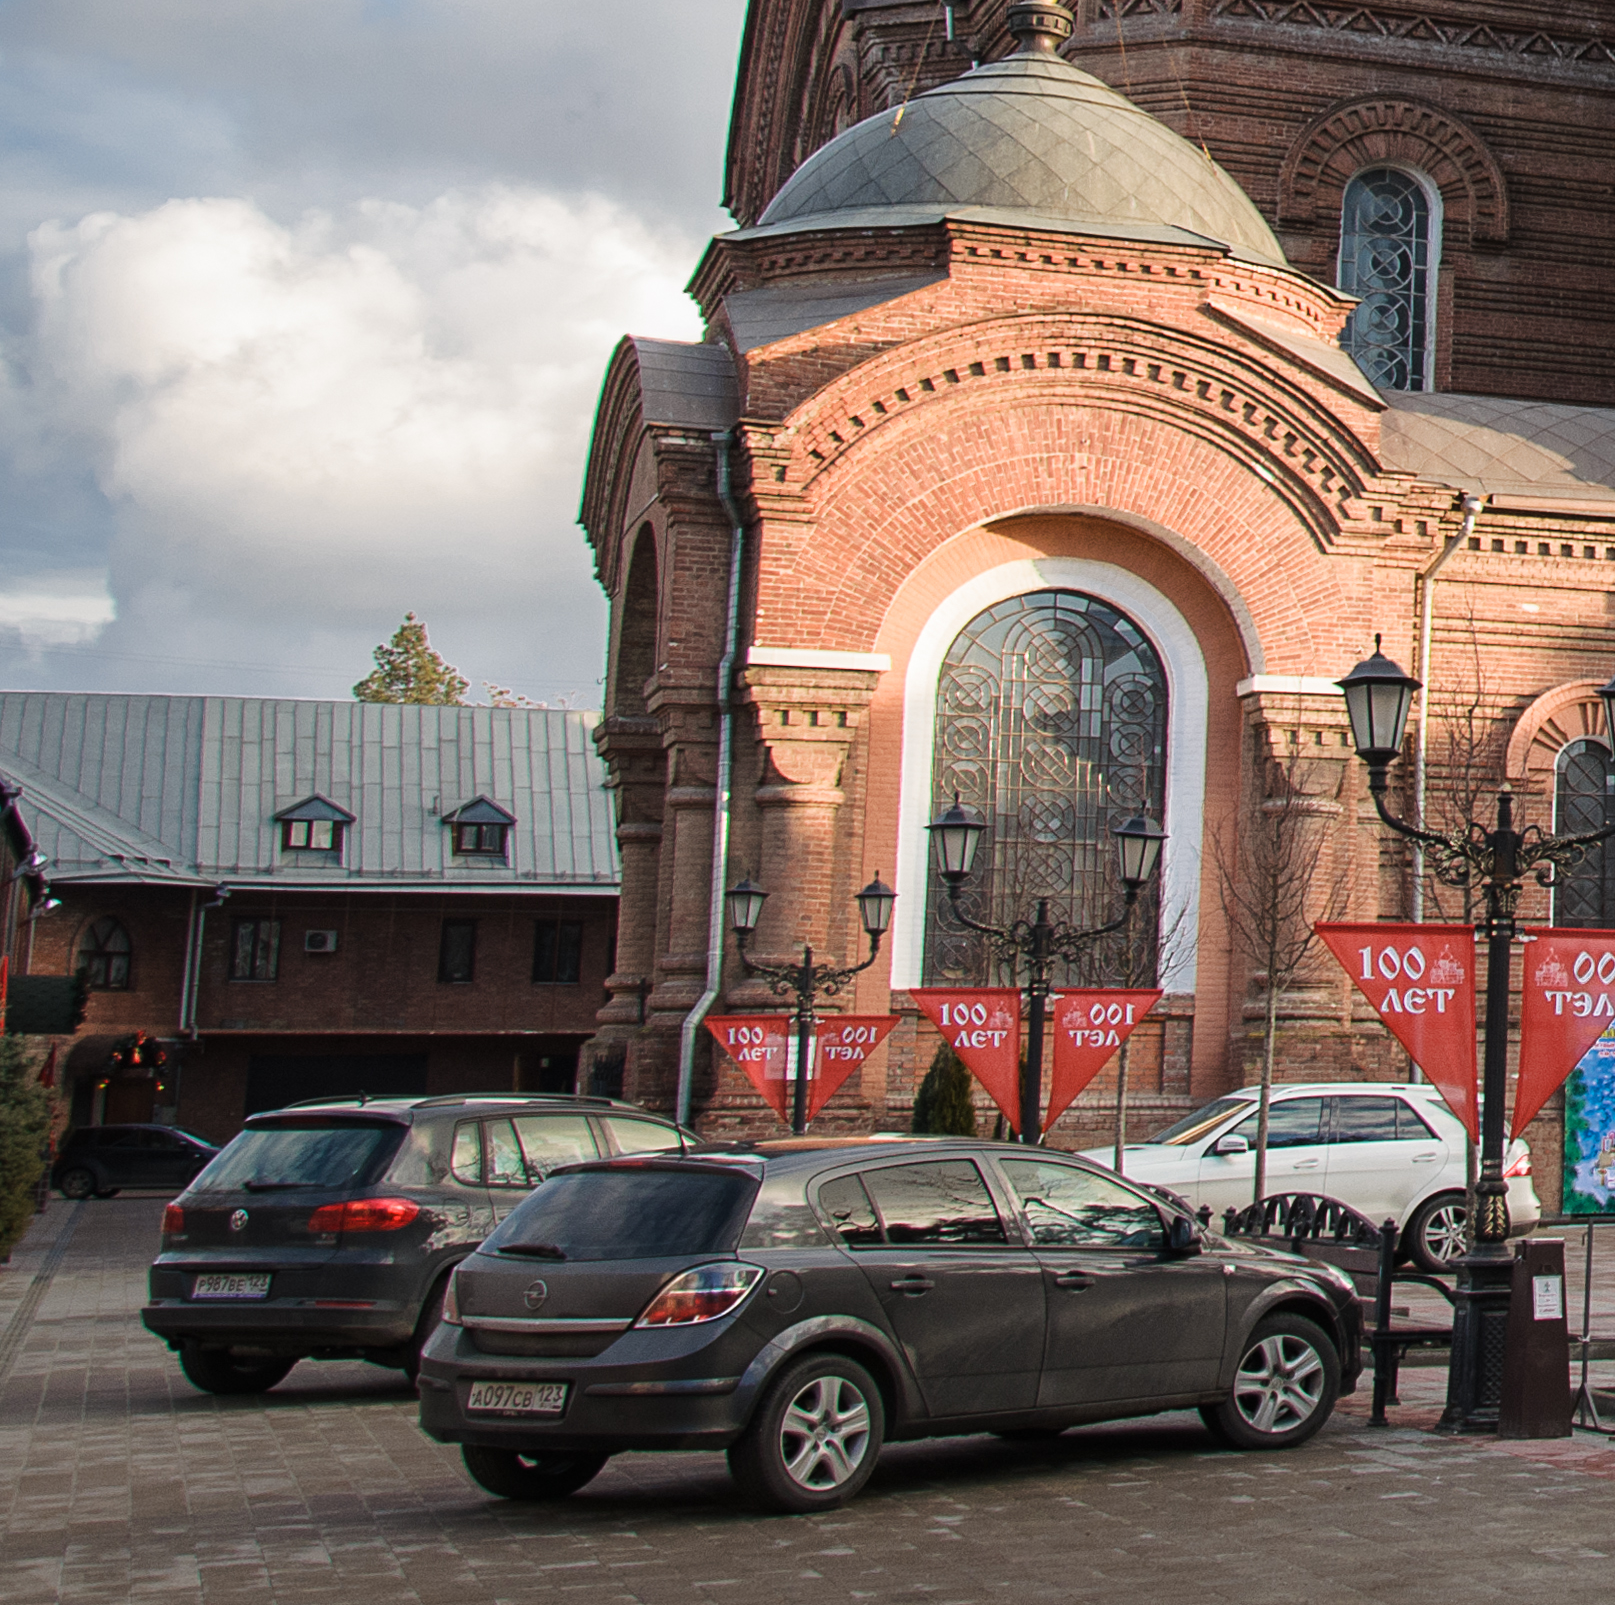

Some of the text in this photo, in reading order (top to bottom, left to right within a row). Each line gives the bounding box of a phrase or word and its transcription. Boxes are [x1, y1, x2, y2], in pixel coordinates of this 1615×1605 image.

[1359, 946, 1426, 980] 100
[1381, 987, 1455, 1014] ЛЕТ
[940, 1002, 987, 1026] 100
[728, 1026, 764, 1045] 100
[955, 1030, 1008, 1048] ЛЕТ
[738, 1046, 779, 1061] ЛЕТ
[472, 1385, 562, 1408] А097СВ 123
